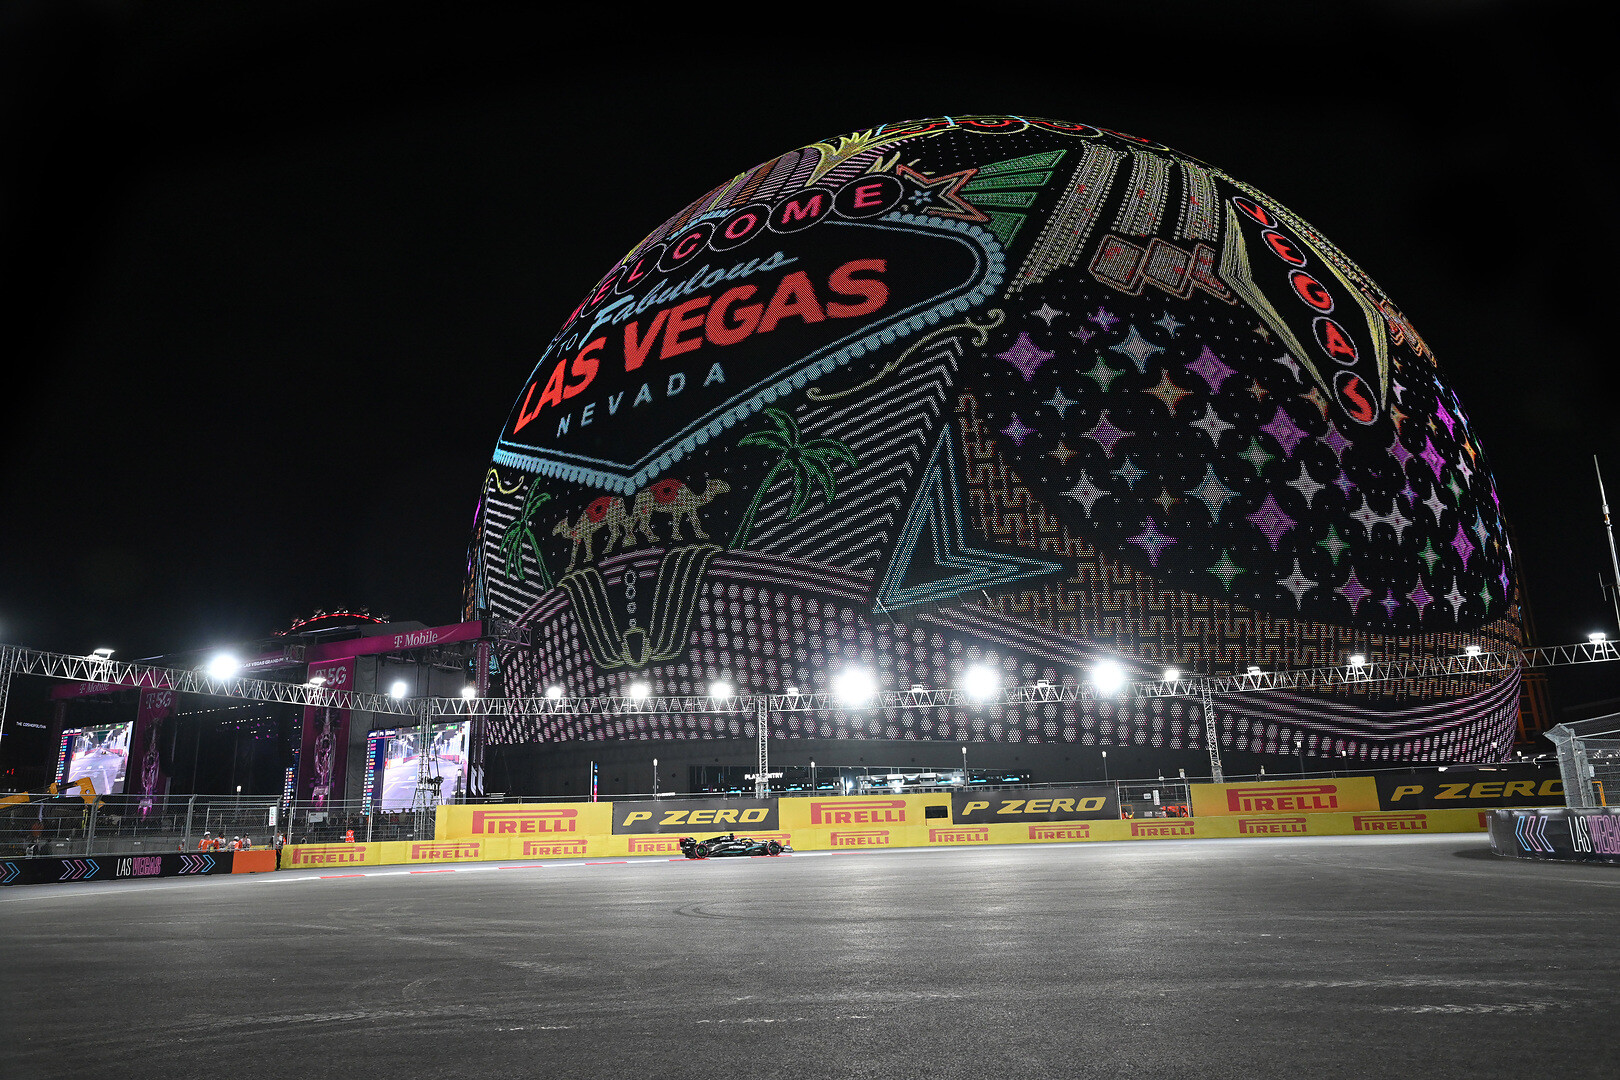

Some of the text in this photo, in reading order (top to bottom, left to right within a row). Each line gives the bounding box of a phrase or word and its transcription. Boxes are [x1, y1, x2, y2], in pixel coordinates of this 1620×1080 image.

[578, 251, 799, 351] Fabulous
[1236, 200, 1373, 423] VEGAS
[513, 258, 890, 435] LAS VEGAS
[556, 362, 727, 438] NEVADA
[404, 630, 438, 647] Mobile
[326, 666, 347, 686] 5G
[1226, 784, 1338, 813] PIRELLI
[1390, 780, 1565, 801] P ZERO
[811, 799, 907, 825] PIRELLI
[962, 796, 1107, 815] P ZERO
[472, 808, 578, 835] PIRELLI
[622, 808, 770, 826] P ZERO
[1239, 817, 1307, 834] PIRELLI
[1353, 814, 1427, 831] PIRELLI
[929, 827, 989, 843] PIRELLI
[1029, 824, 1090, 840] PIRELLI
[1131, 820, 1195, 837] PIRELLI
[1567, 815, 1620, 854] LAS VEGA
[628, 836, 690, 853] PIRELL
[831, 830, 890, 846] PIRELLI
[292, 846, 367, 865] PIRELLI
[412, 842, 481, 860] PIRELLI
[523, 839, 588, 856] PIRELLI
[116, 858, 132, 876] LAS
